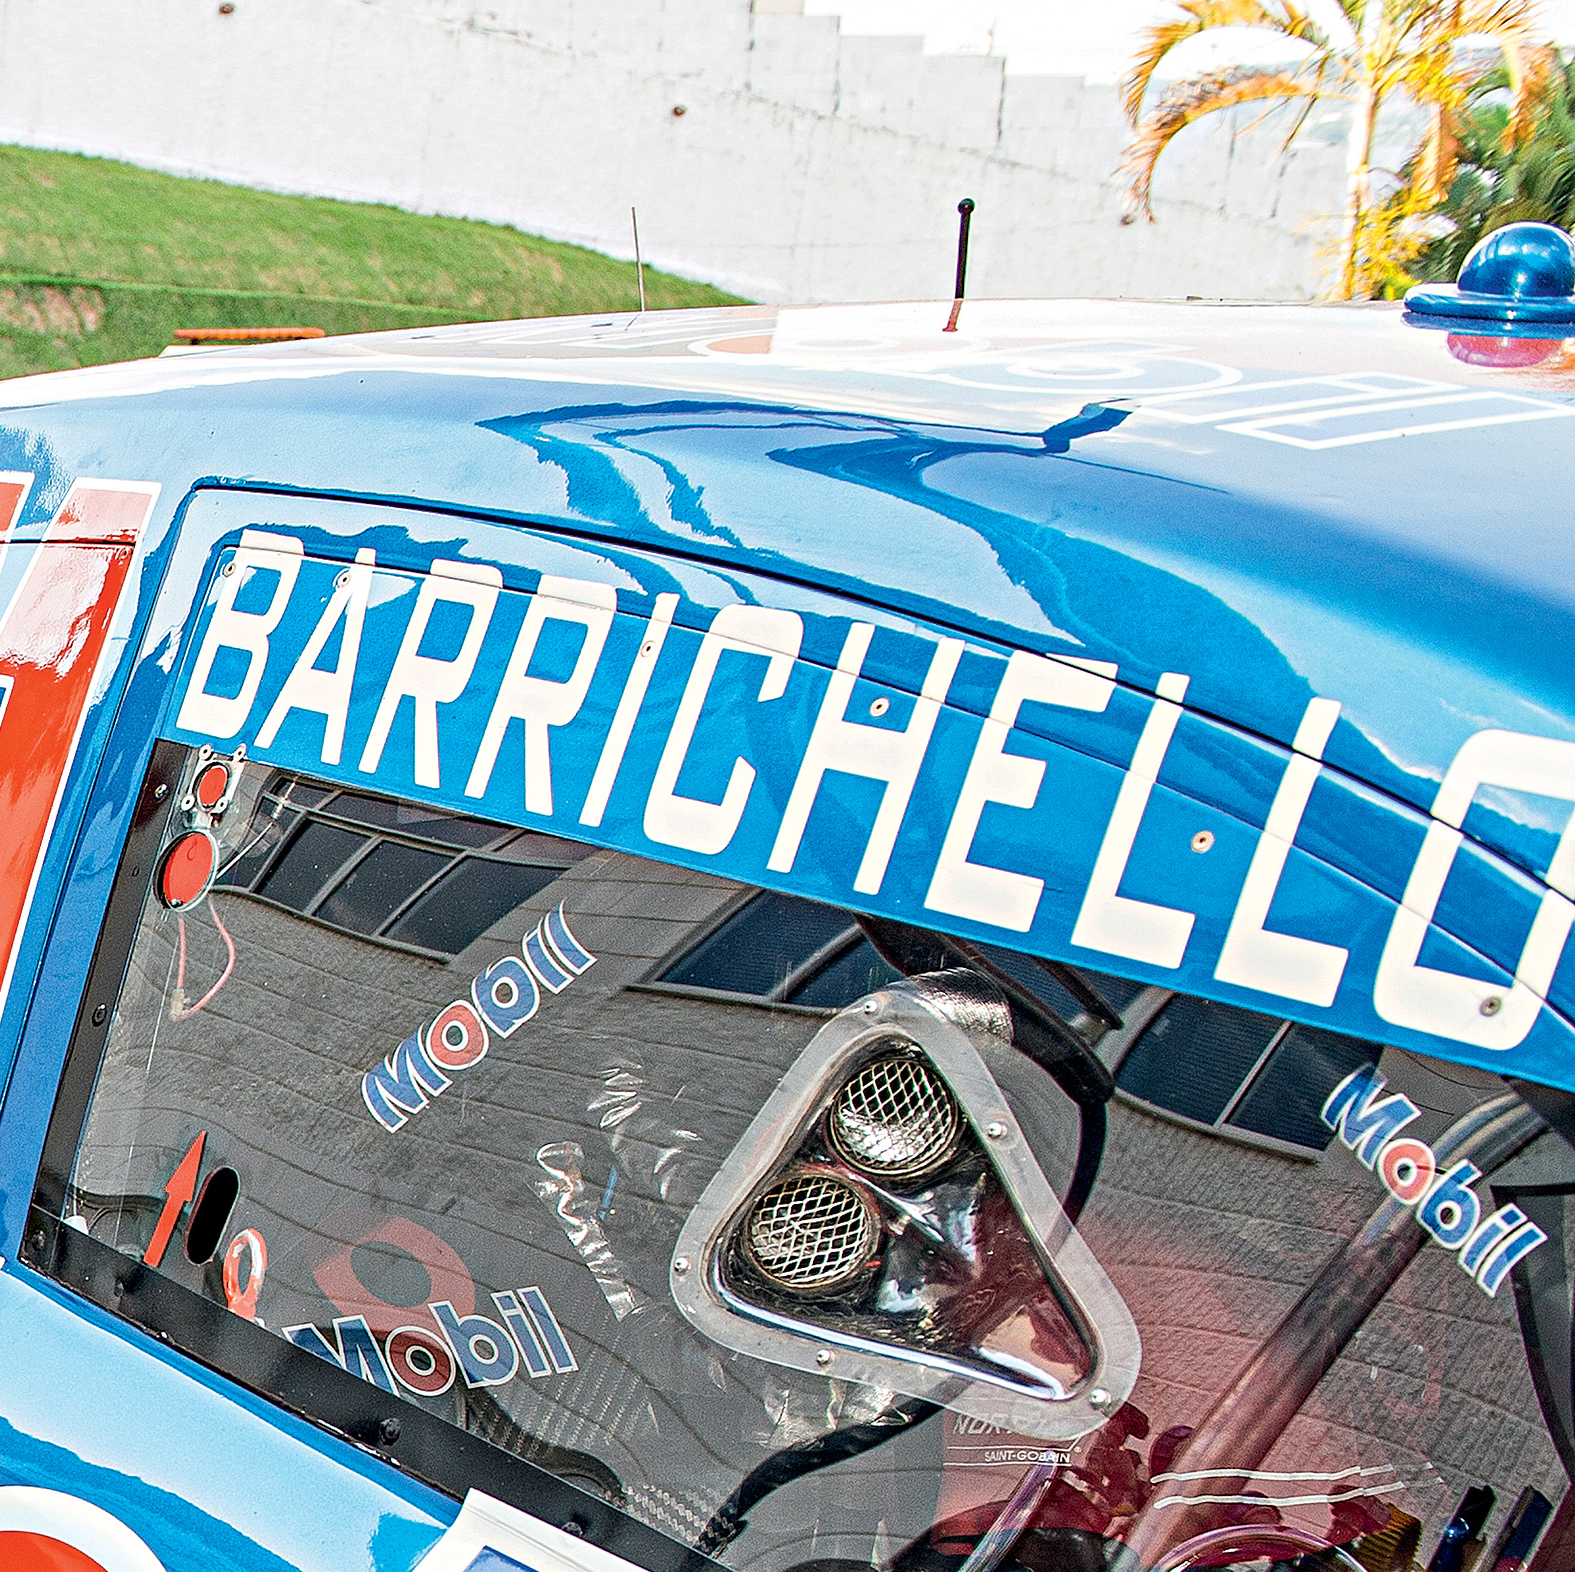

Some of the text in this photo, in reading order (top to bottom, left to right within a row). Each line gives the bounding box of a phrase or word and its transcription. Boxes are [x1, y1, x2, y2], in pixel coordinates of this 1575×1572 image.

[176, 529, 1575, 1051] BARRICHELLO
[361, 900, 597, 1133] Mobil
[1322, 1064, 1549, 1298] Mobil
[282, 1286, 579, 1397] Mobil
[984, 1450, 1071, 1463] SAINT-GOBAIN
